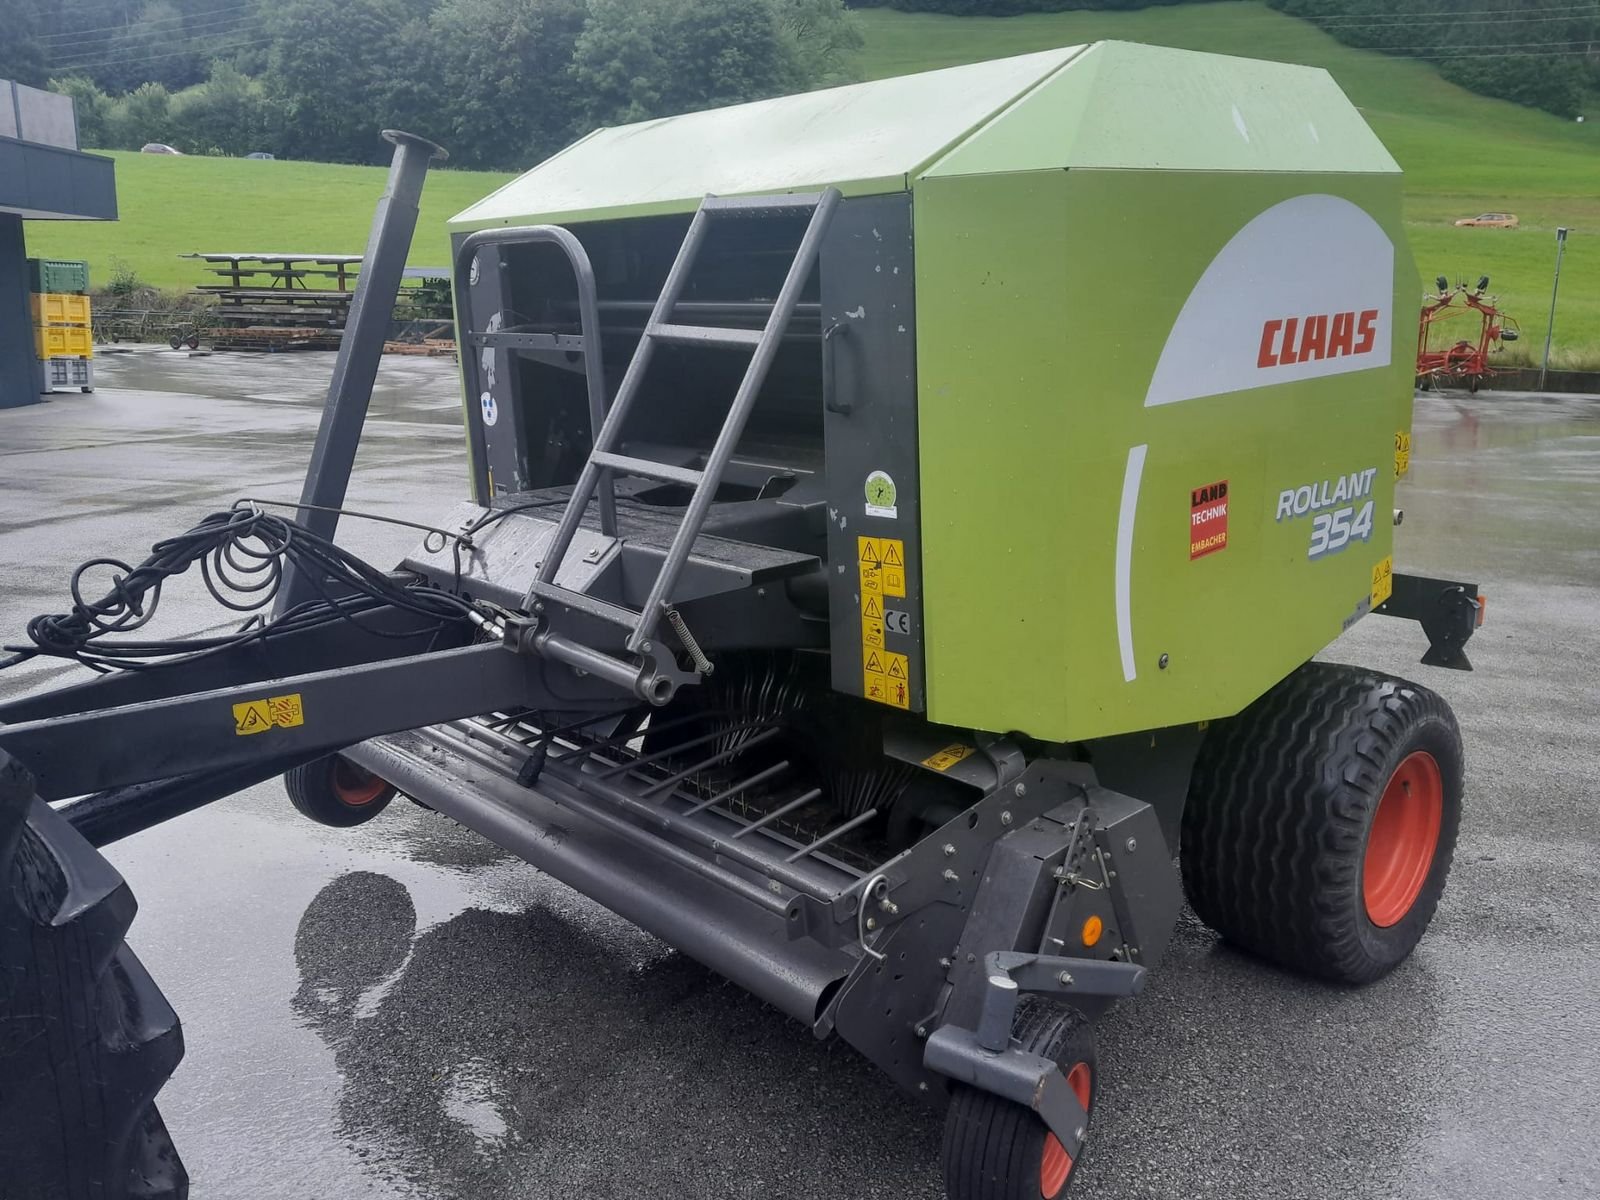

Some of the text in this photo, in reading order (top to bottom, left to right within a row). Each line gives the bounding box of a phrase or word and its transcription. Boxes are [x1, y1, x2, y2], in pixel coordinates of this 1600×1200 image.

[1257, 309, 1379, 368] CLAAS
[1192, 483, 1227, 507] LAND
[1276, 467, 1377, 521] ROLLANT
[1192, 503, 1227, 526] TECHNIK
[1308, 500, 1374, 558] 354
[1191, 532, 1226, 553] EMBACHER
[885, 611, 908, 633] CE
